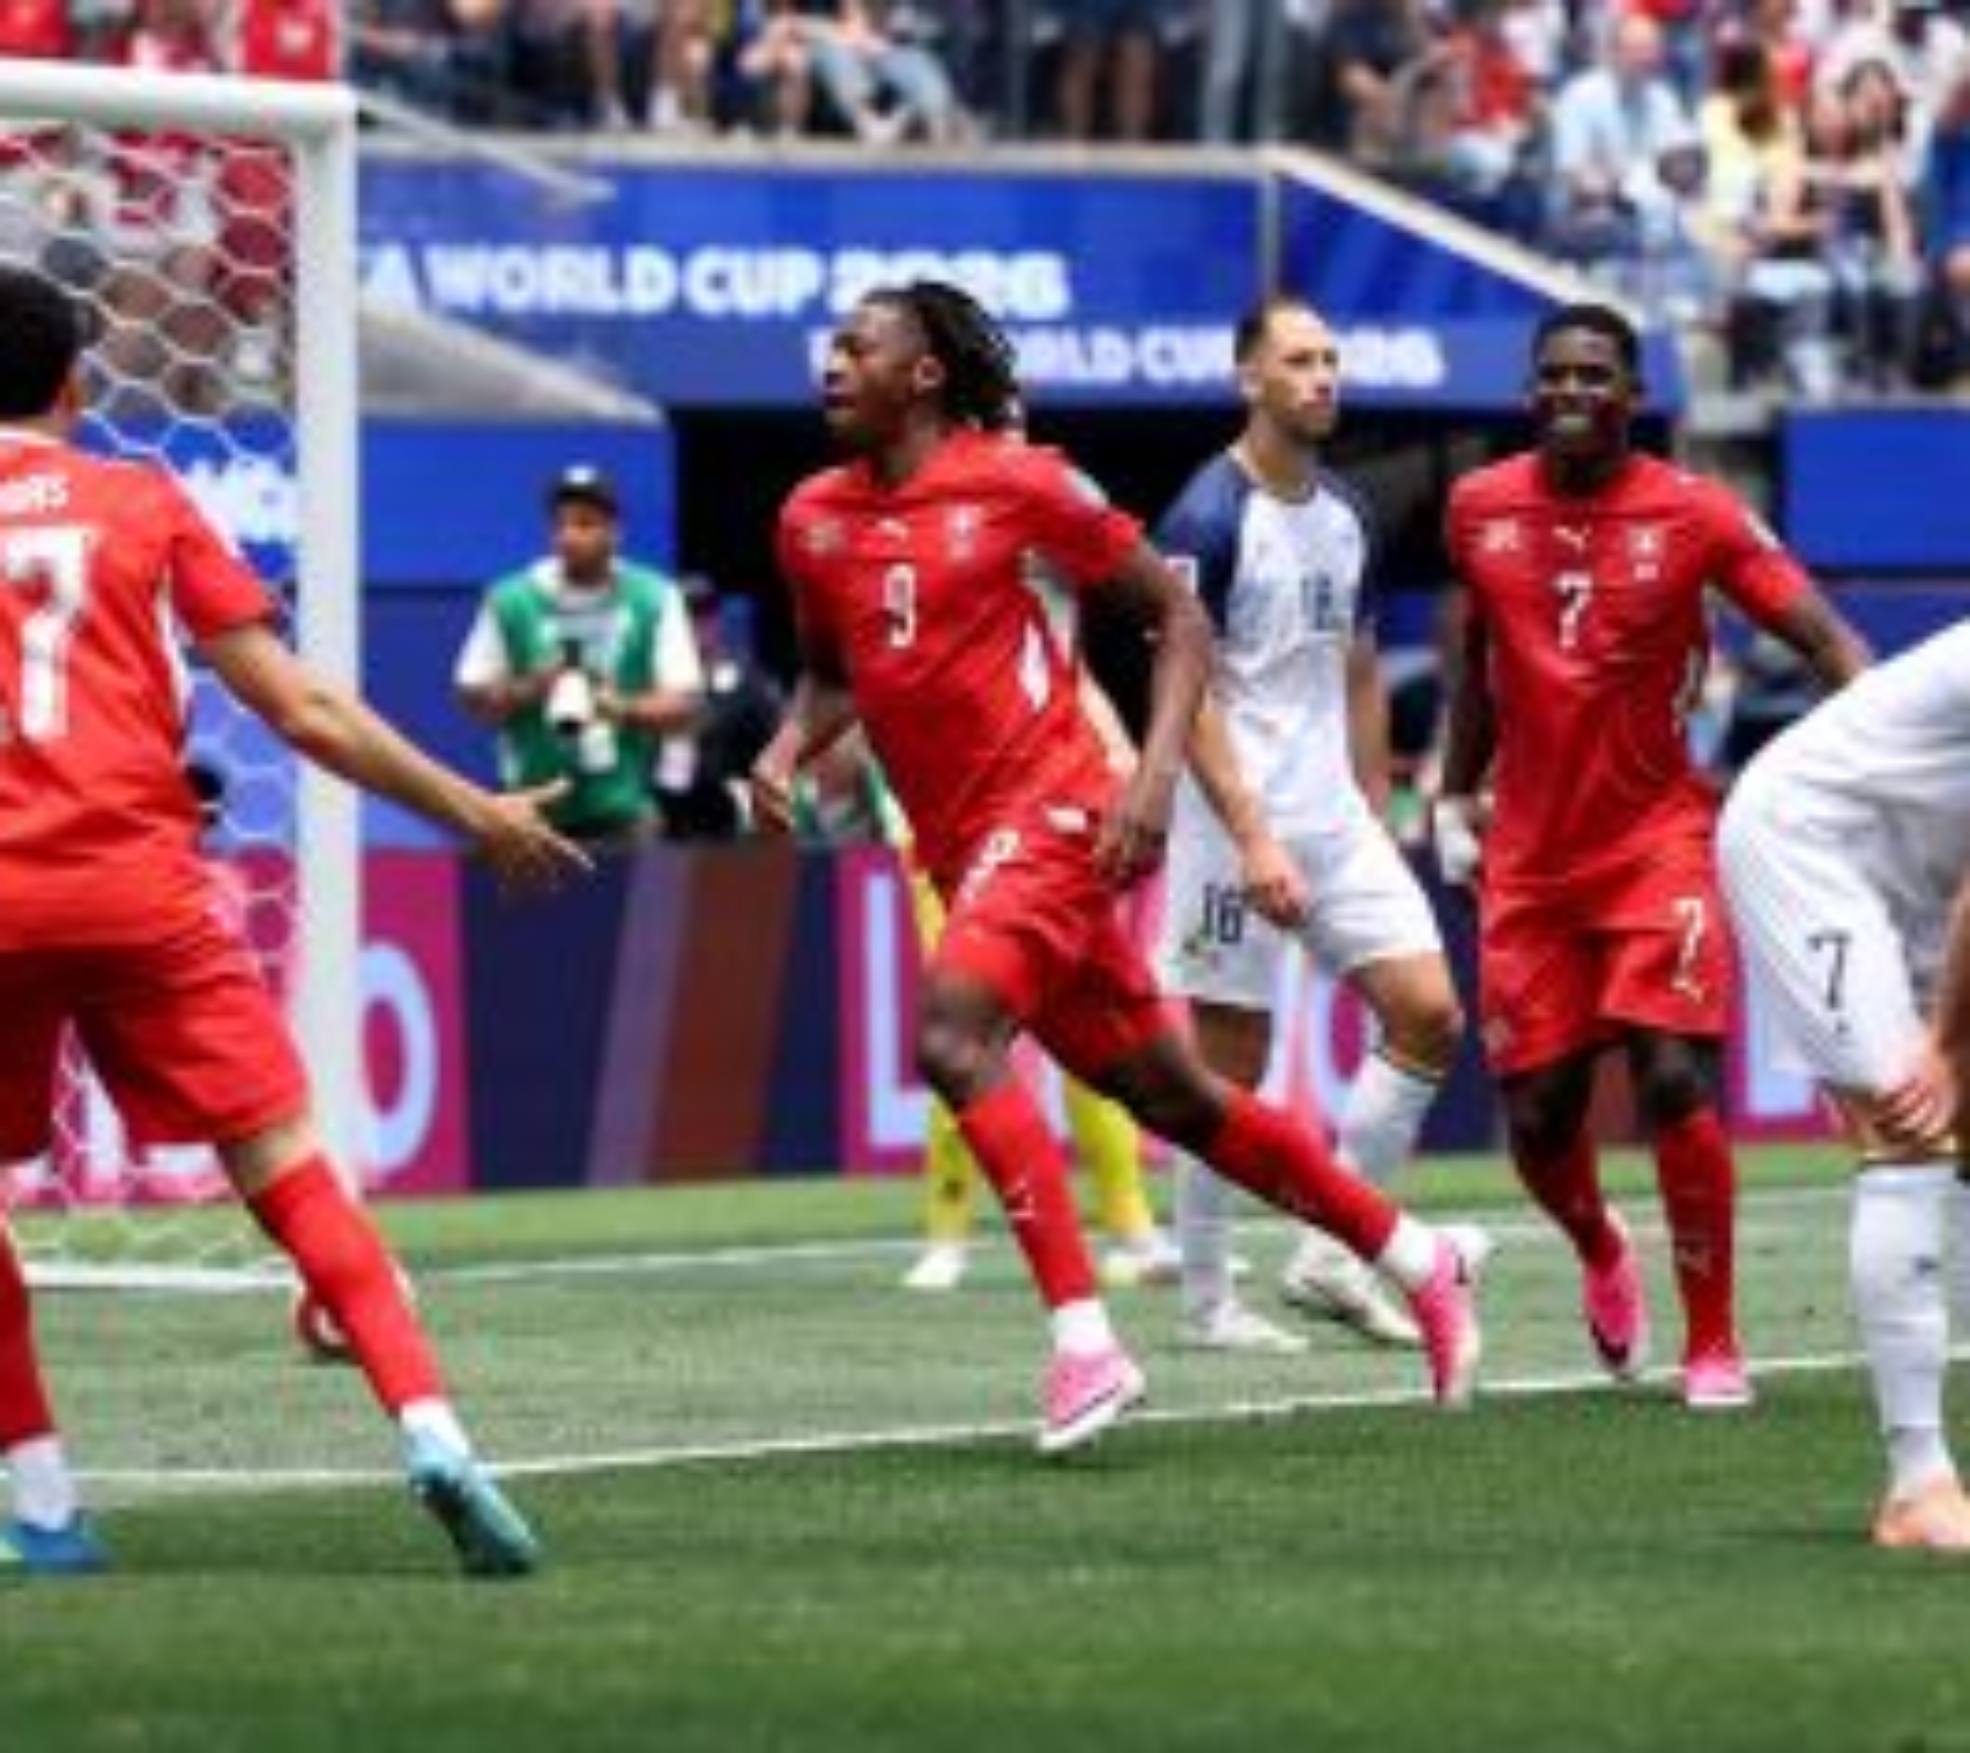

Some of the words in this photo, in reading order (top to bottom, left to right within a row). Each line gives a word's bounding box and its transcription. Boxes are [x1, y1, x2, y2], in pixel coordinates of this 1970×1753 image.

[421, 241, 680, 315] WORLD
[685, 243, 822, 316] CUP
[883, 563, 916, 648] 9
[1556, 571, 1593, 651] 7
[1805, 928, 1852, 1012] 7
